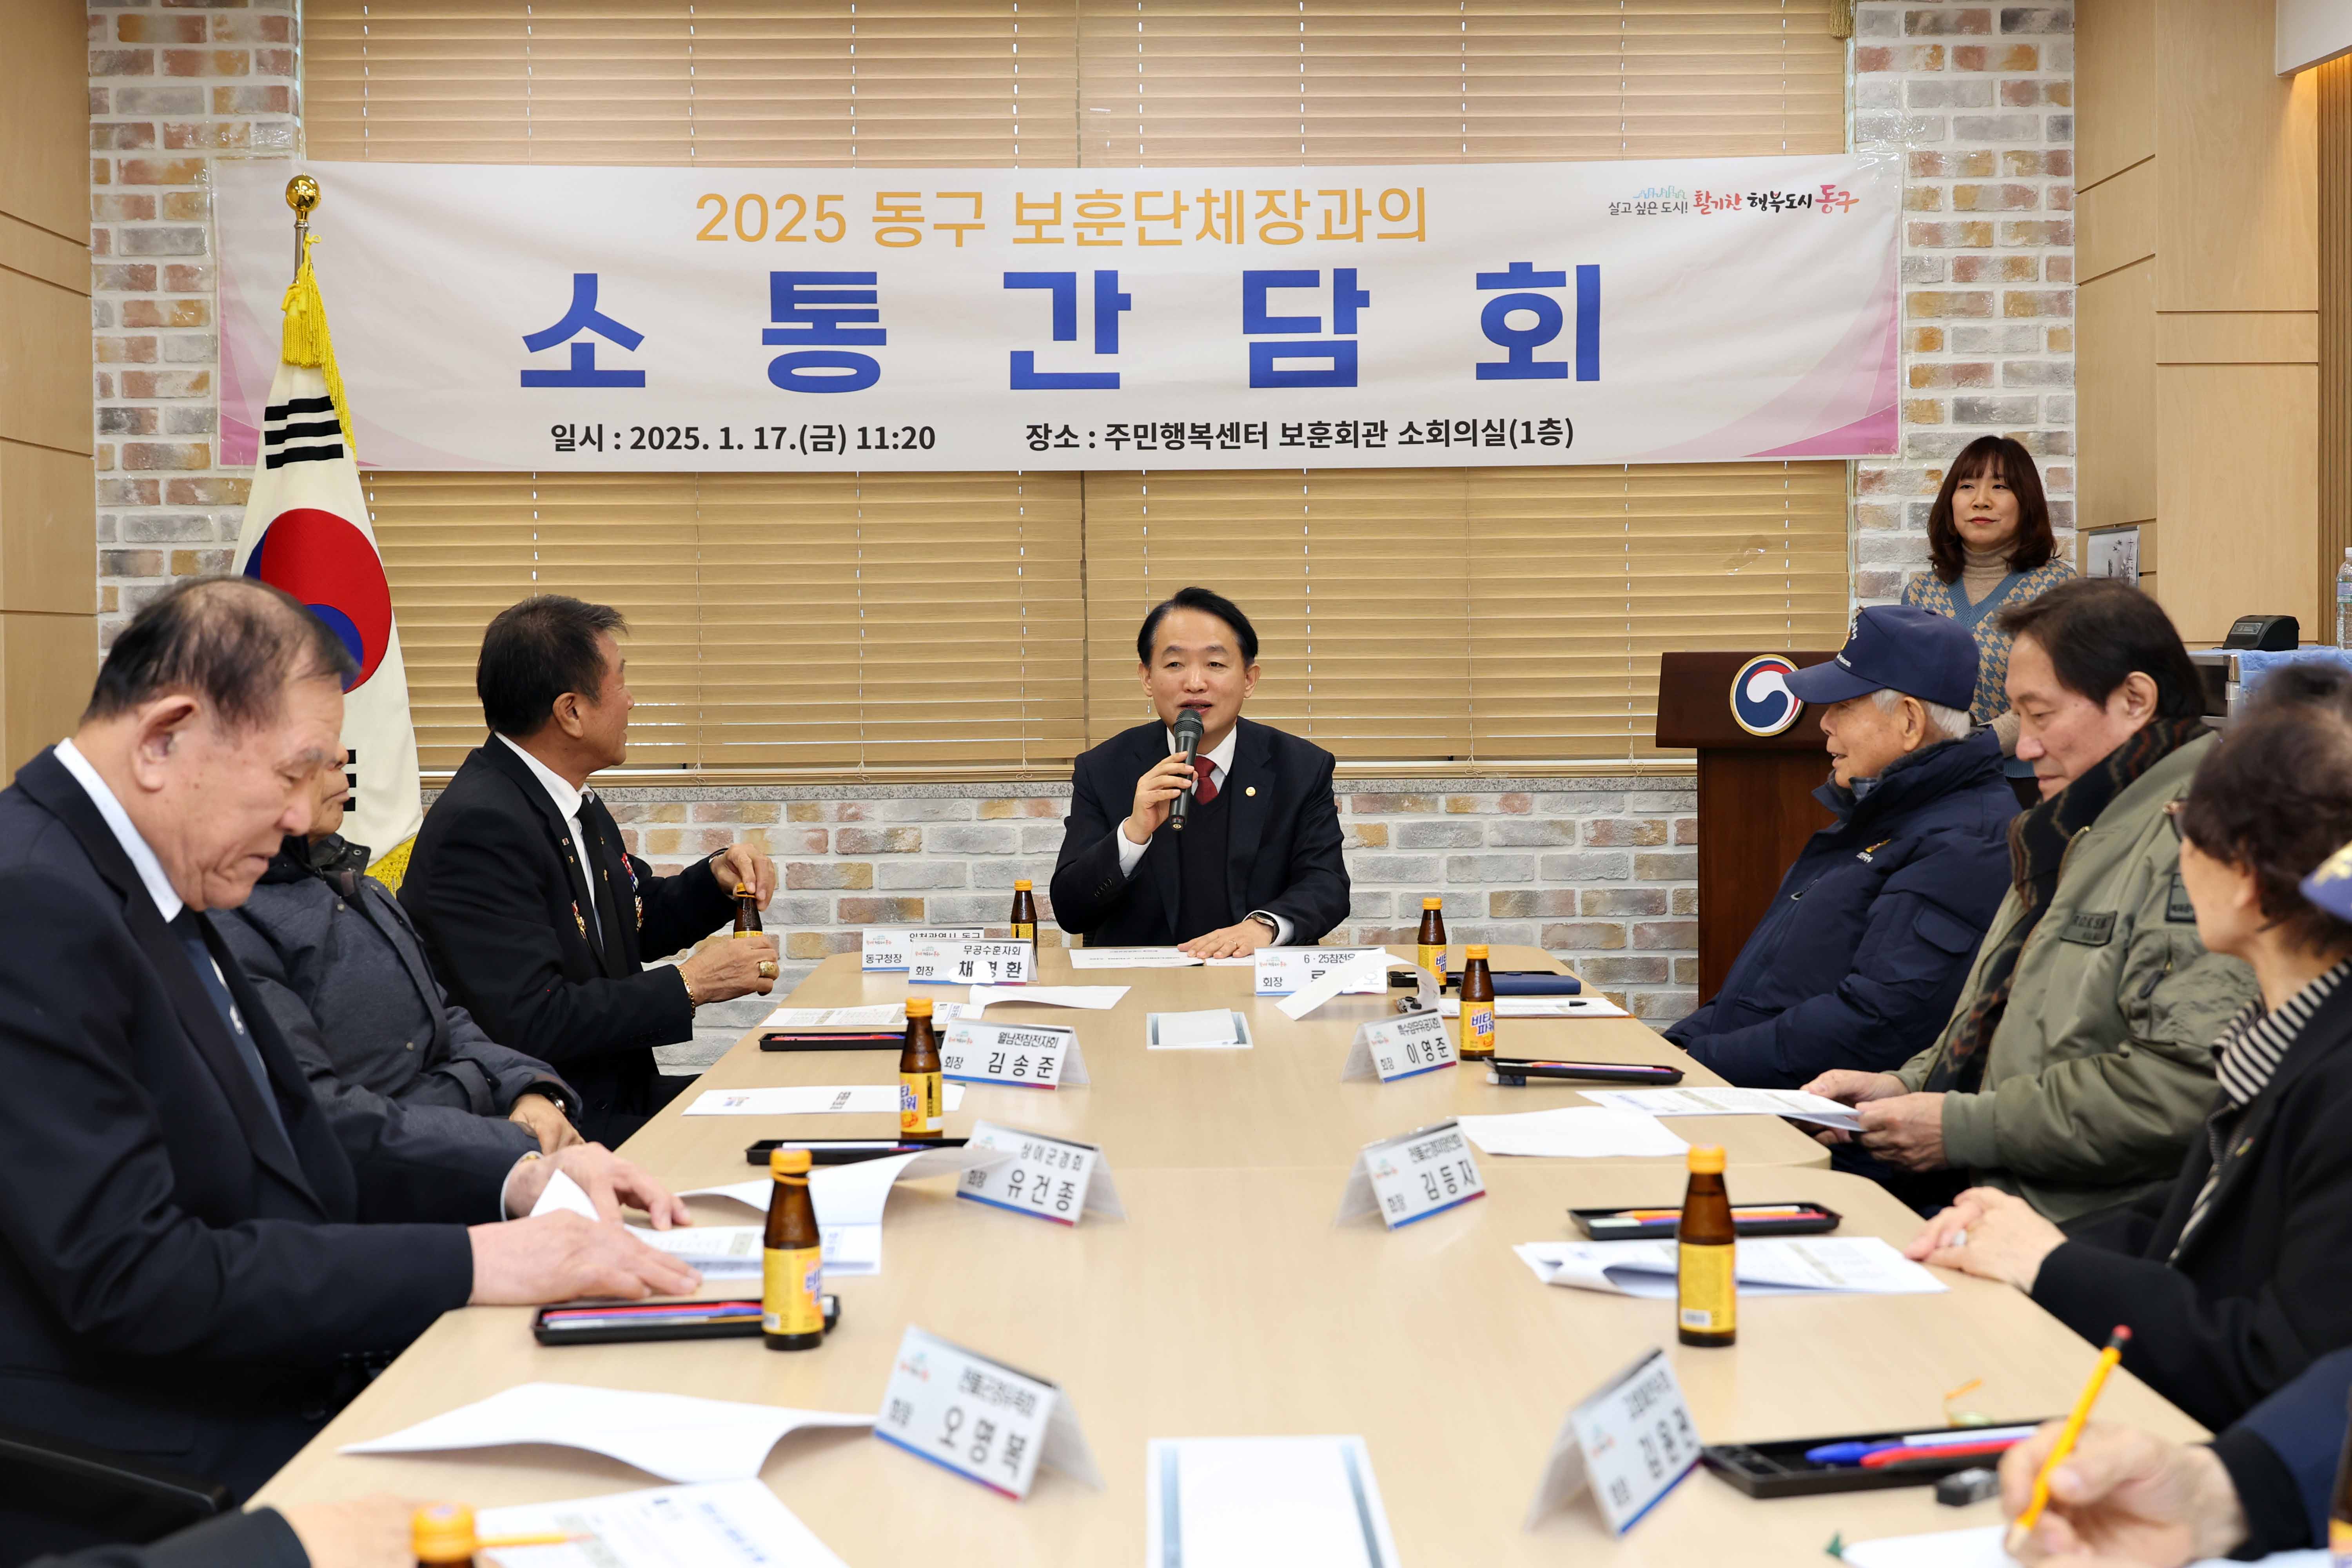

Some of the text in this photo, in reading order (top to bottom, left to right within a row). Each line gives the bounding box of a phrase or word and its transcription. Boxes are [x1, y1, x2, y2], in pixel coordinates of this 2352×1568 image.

[1608, 184, 1859, 215] 살고 싶은 도시! 활기찬 행복도시 동구
[697, 188, 1425, 247] 2025 동구 보훈단체장과의
[552, 424, 602, 452] 일시
[630, 427, 708, 450] 2025.
[720, 427, 743, 450] 1.
[755, 425, 846, 455] 17.(금)
[857, 426, 935, 450] 11:20
[1026, 423, 1079, 451] 장소
[1105, 422, 1267, 450] 주민행복센터
[1279, 420, 1388, 448] 보훈회관
[1399, 418, 1573, 449] 소회의실(1층)
[963, 945, 1021, 956] 무공수훈자회
[866, 953, 902, 964] 동구청장
[915, 966, 934, 976] 회장
[1263, 976, 1283, 987] 회장
[1472, 1011, 1491, 1026] 비타
[997, 1031, 1060, 1049] 월남전참전자회
[944, 1056, 964, 1069] 회장
[1380, 1056, 1394, 1071] 회장
